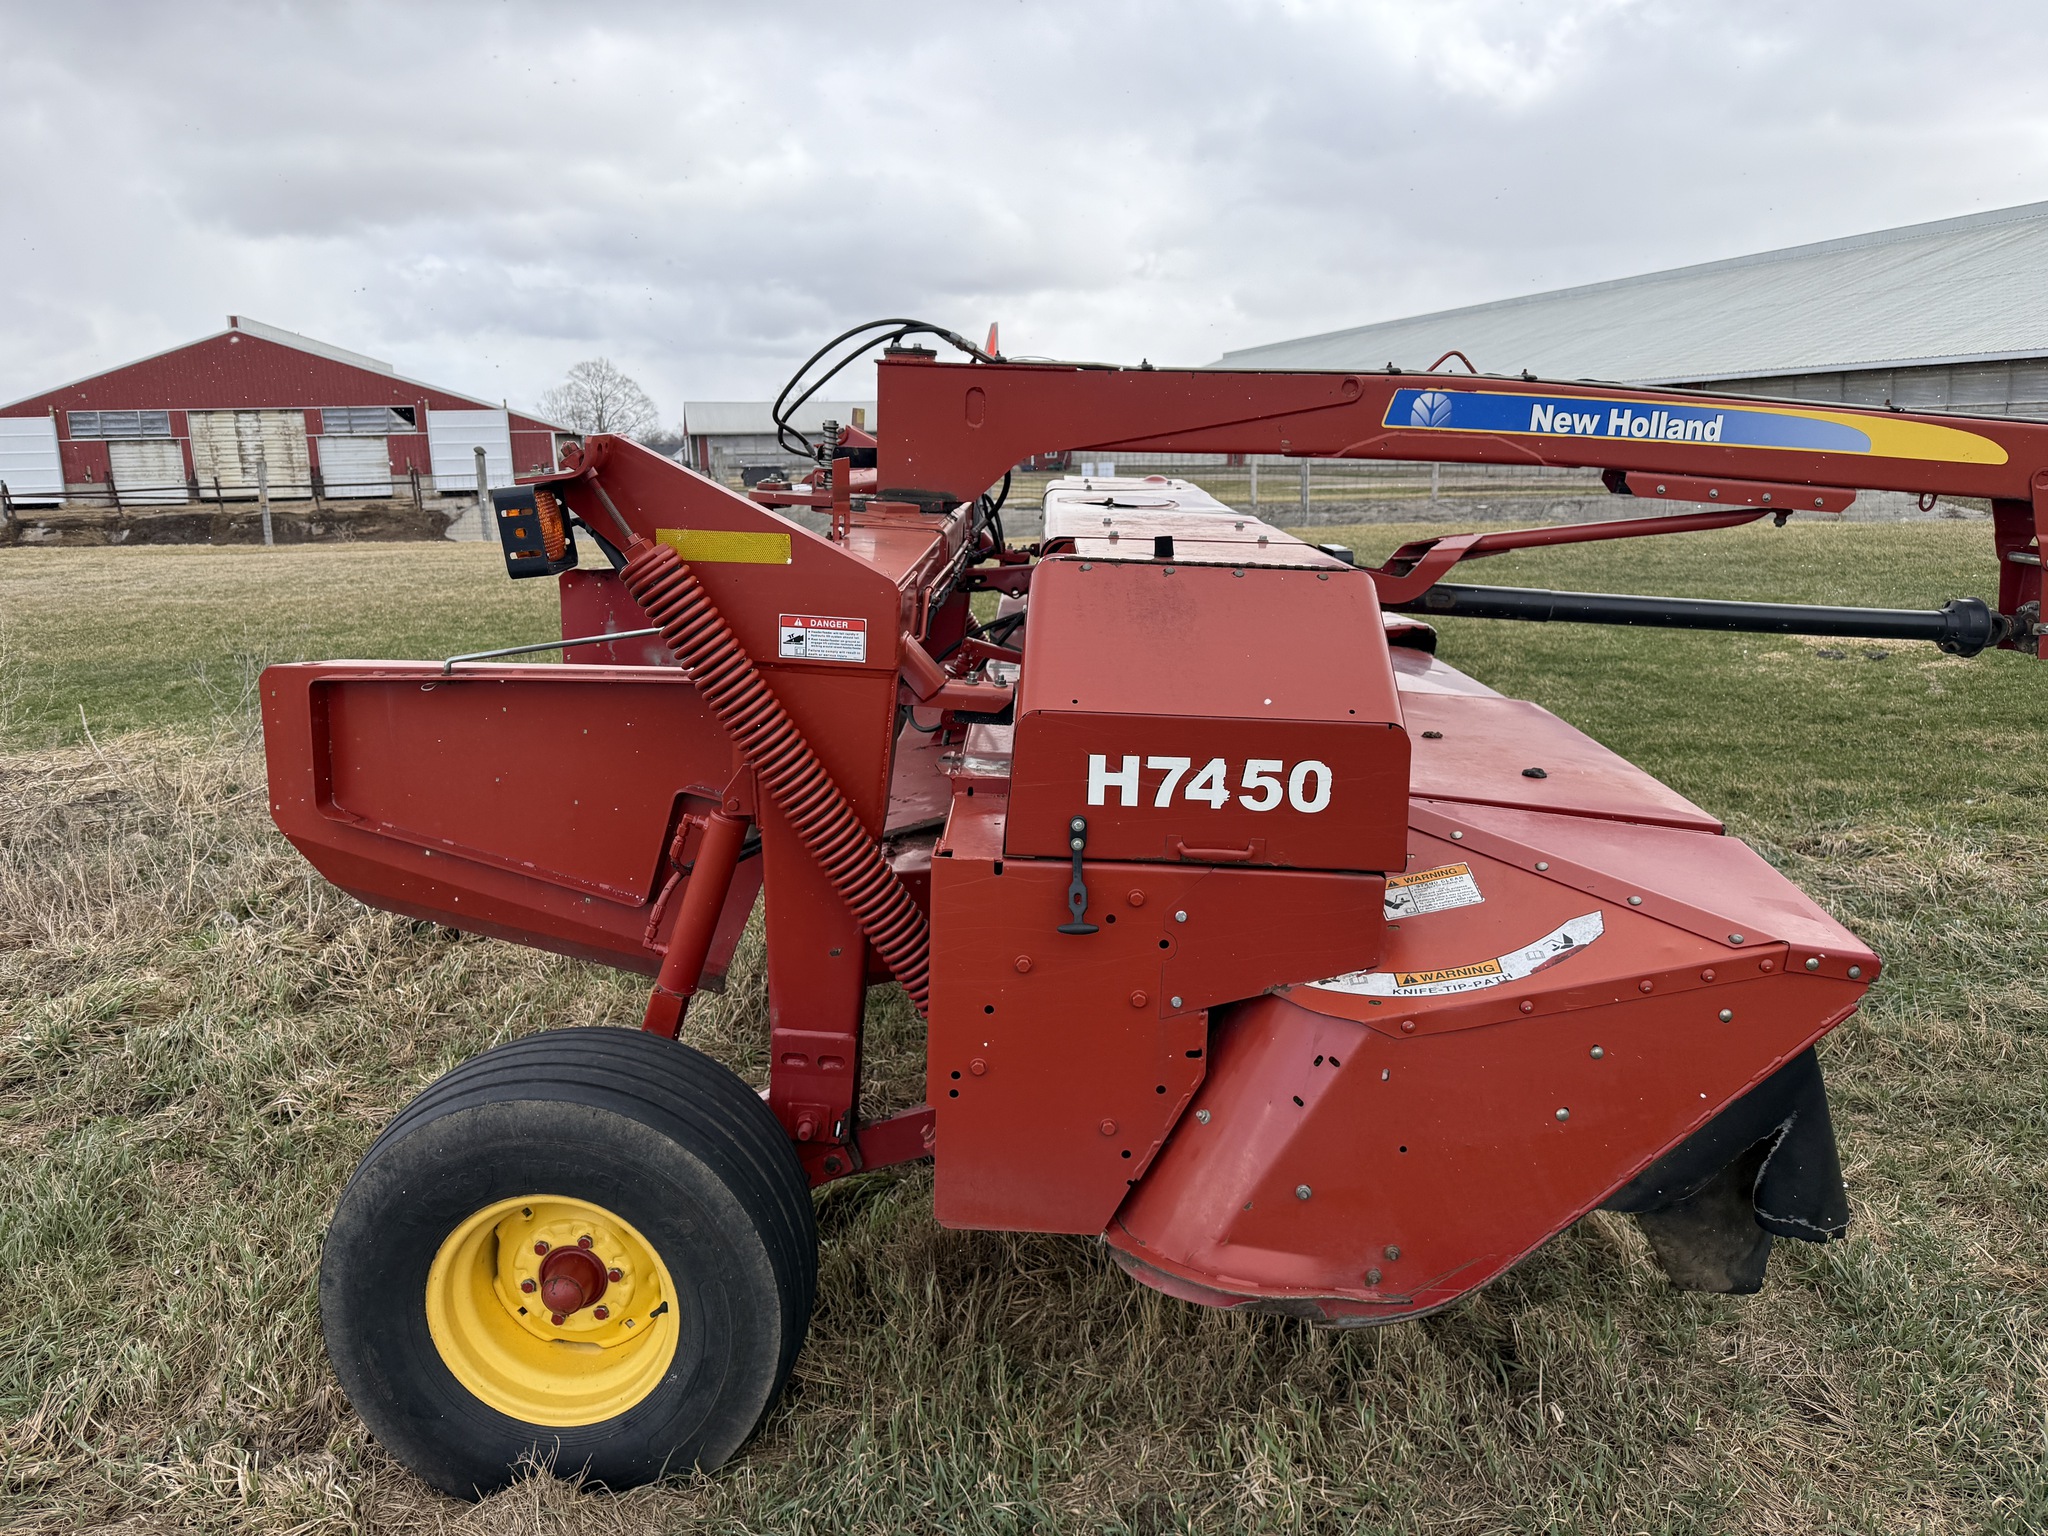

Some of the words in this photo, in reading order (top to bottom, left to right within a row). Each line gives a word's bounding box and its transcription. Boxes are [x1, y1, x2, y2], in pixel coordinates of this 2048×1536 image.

[1529, 404, 1601, 434] New
[1607, 408, 1724, 442] Holland
[810, 619, 849, 629] DANGER
[1087, 754, 1333, 813] H7450
[1403, 867, 1457, 884] WARNING
[1419, 964, 1495, 982] WARNING
[1392, 972, 1513, 995] KNIFE-TIP-PATH
